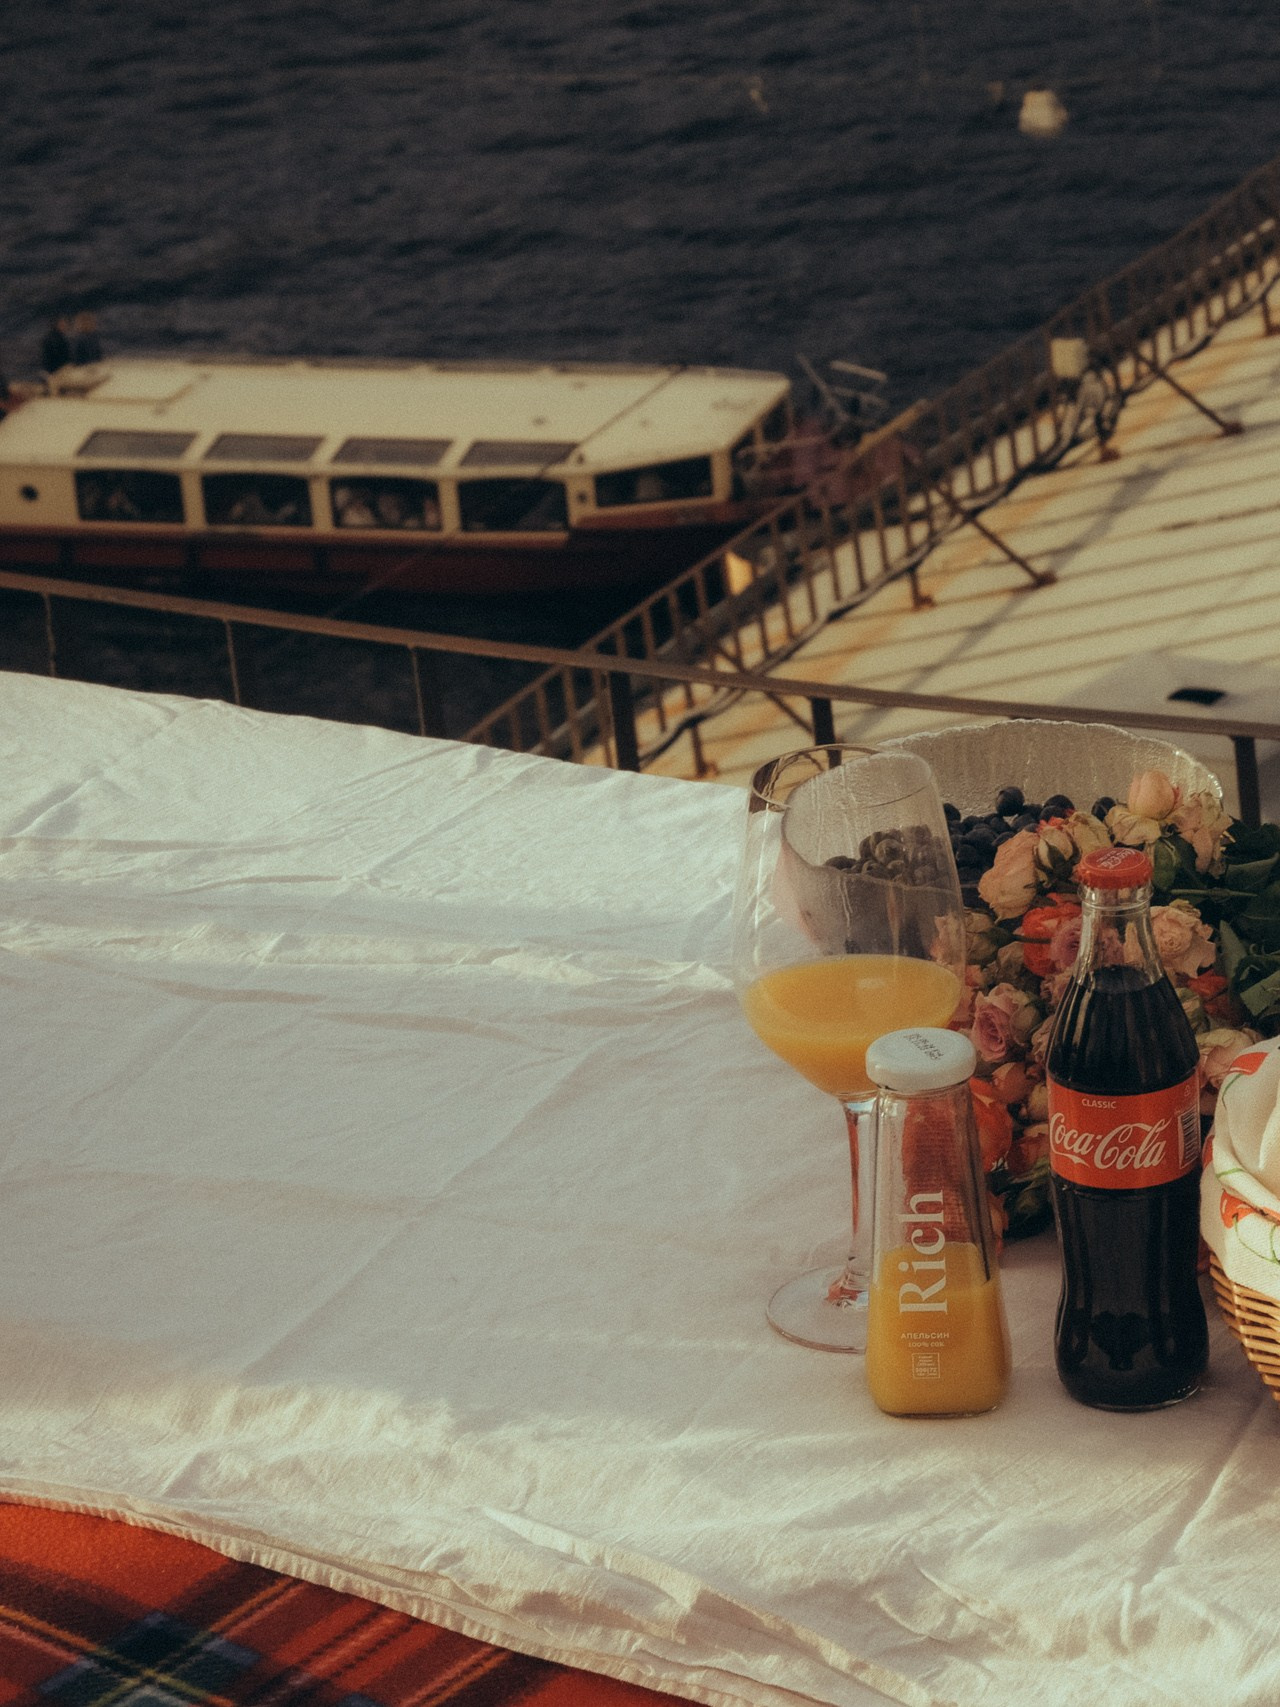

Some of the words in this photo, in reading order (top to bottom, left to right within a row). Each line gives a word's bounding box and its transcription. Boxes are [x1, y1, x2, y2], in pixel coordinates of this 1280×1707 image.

[1081, 1098, 1117, 1109] CLASSIC
[1050, 1112, 1173, 1170] Coca-Cola
[897, 1189, 948, 1315] Rich
[900, 1332, 950, 1340] АПЕЛЬСИН
